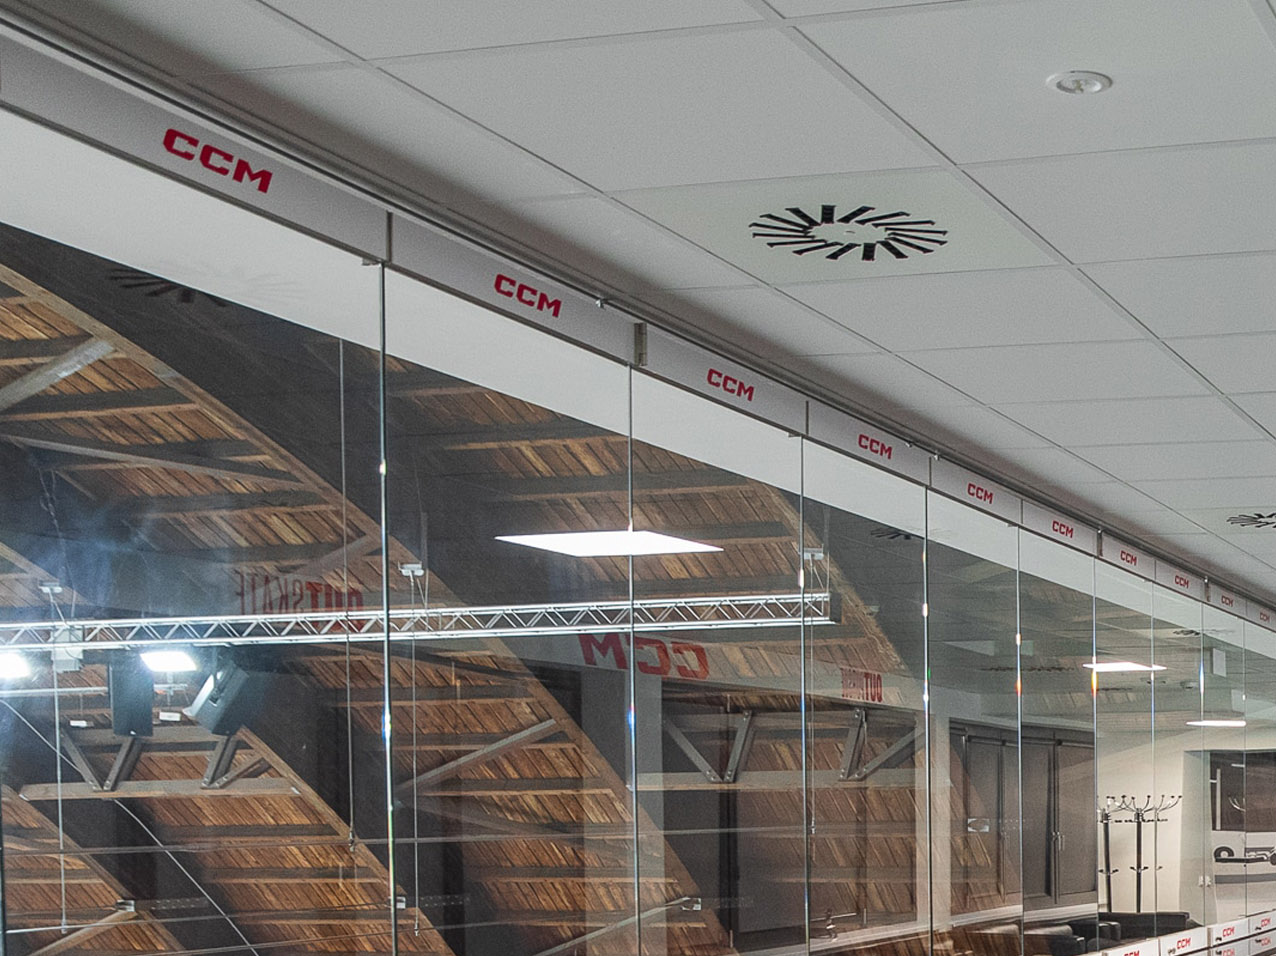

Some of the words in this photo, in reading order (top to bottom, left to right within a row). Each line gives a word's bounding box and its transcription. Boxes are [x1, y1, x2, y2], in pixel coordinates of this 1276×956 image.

[162, 128, 273, 193] CCM
[493, 273, 562, 317] CCM
[706, 368, 755, 401] CCM
[857, 433, 893, 460] CCM
[967, 482, 994, 504] CCM
[1052, 519, 1074, 539] CCM
[1120, 550, 1137, 566] CCM
[1174, 575, 1189, 589] CCM
[1176, 937, 1192, 950] CCM
